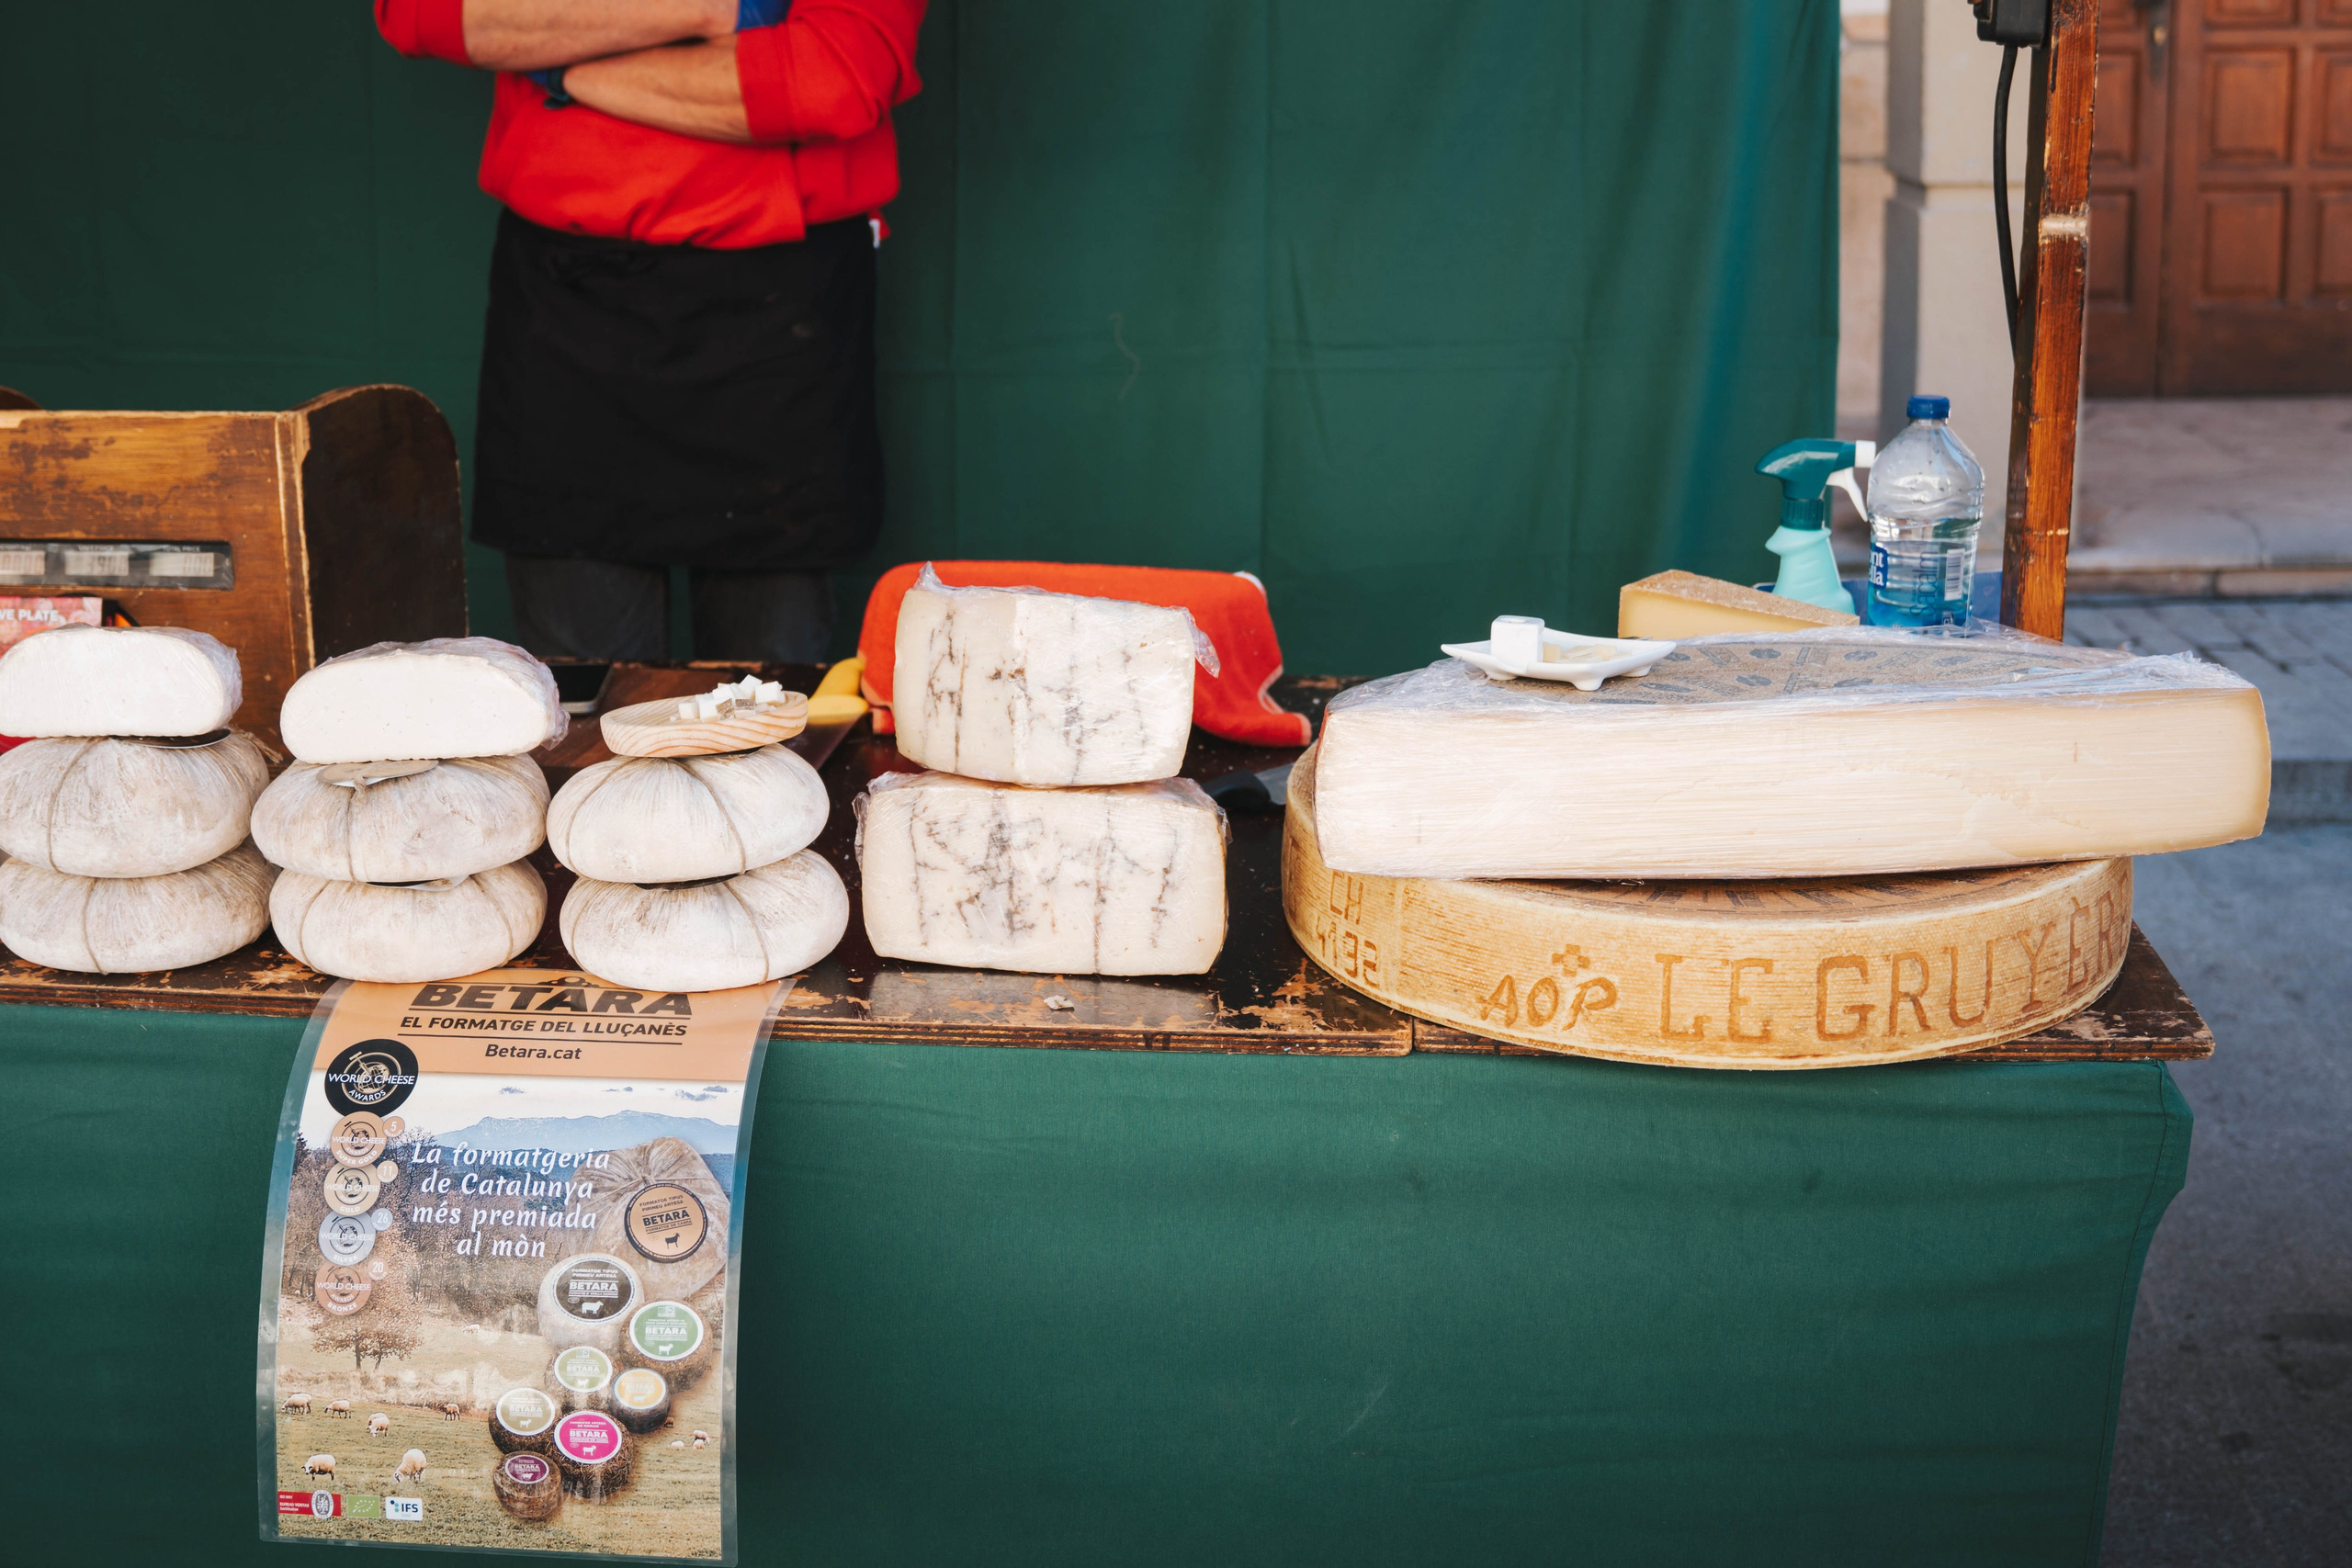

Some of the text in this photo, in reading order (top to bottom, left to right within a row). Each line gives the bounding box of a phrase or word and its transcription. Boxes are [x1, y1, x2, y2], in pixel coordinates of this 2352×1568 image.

[18, 609, 59, 621] PLATE
[1329, 870, 1363, 925] CH
[411, 984, 693, 1016] BETARA
[1478, 975, 1618, 1031] AOP
[1655, 952, 1774, 1045] LE
[401, 1016, 688, 1038] EL FORMATGE DEL LLUÇANÈS
[485, 1043, 582, 1060] Betara.cat
[328, 1073, 415, 1085] WORLD CHEESE
[349, 1089, 386, 1101] AWARDS
[390, 1122, 397, 1132] 5
[336, 1150, 378, 1165] SUPER GOLD
[412, 1141, 610, 1175] La formatgeria
[383, 1166, 392, 1176] 11
[354, 1184, 379, 1192] CHEESE
[422, 1168, 594, 1205] de Catalunya
[377, 1213, 389, 1224] 26
[413, 1201, 596, 1233] més premiada
[642, 1210, 690, 1226] BETARA
[457, 1232, 546, 1258] al mòn
[372, 1261, 384, 1273] 20
[317, 1281, 344, 1290] WORLD
[569, 1281, 618, 1291] BETARA
[331, 1293, 355, 1303] AWARDS
[327, 1302, 357, 1312] BRONZE
[645, 1326, 687, 1335] BETARA
[570, 1430, 608, 1438] BETARA
[401, 1503, 419, 1513] IFS
